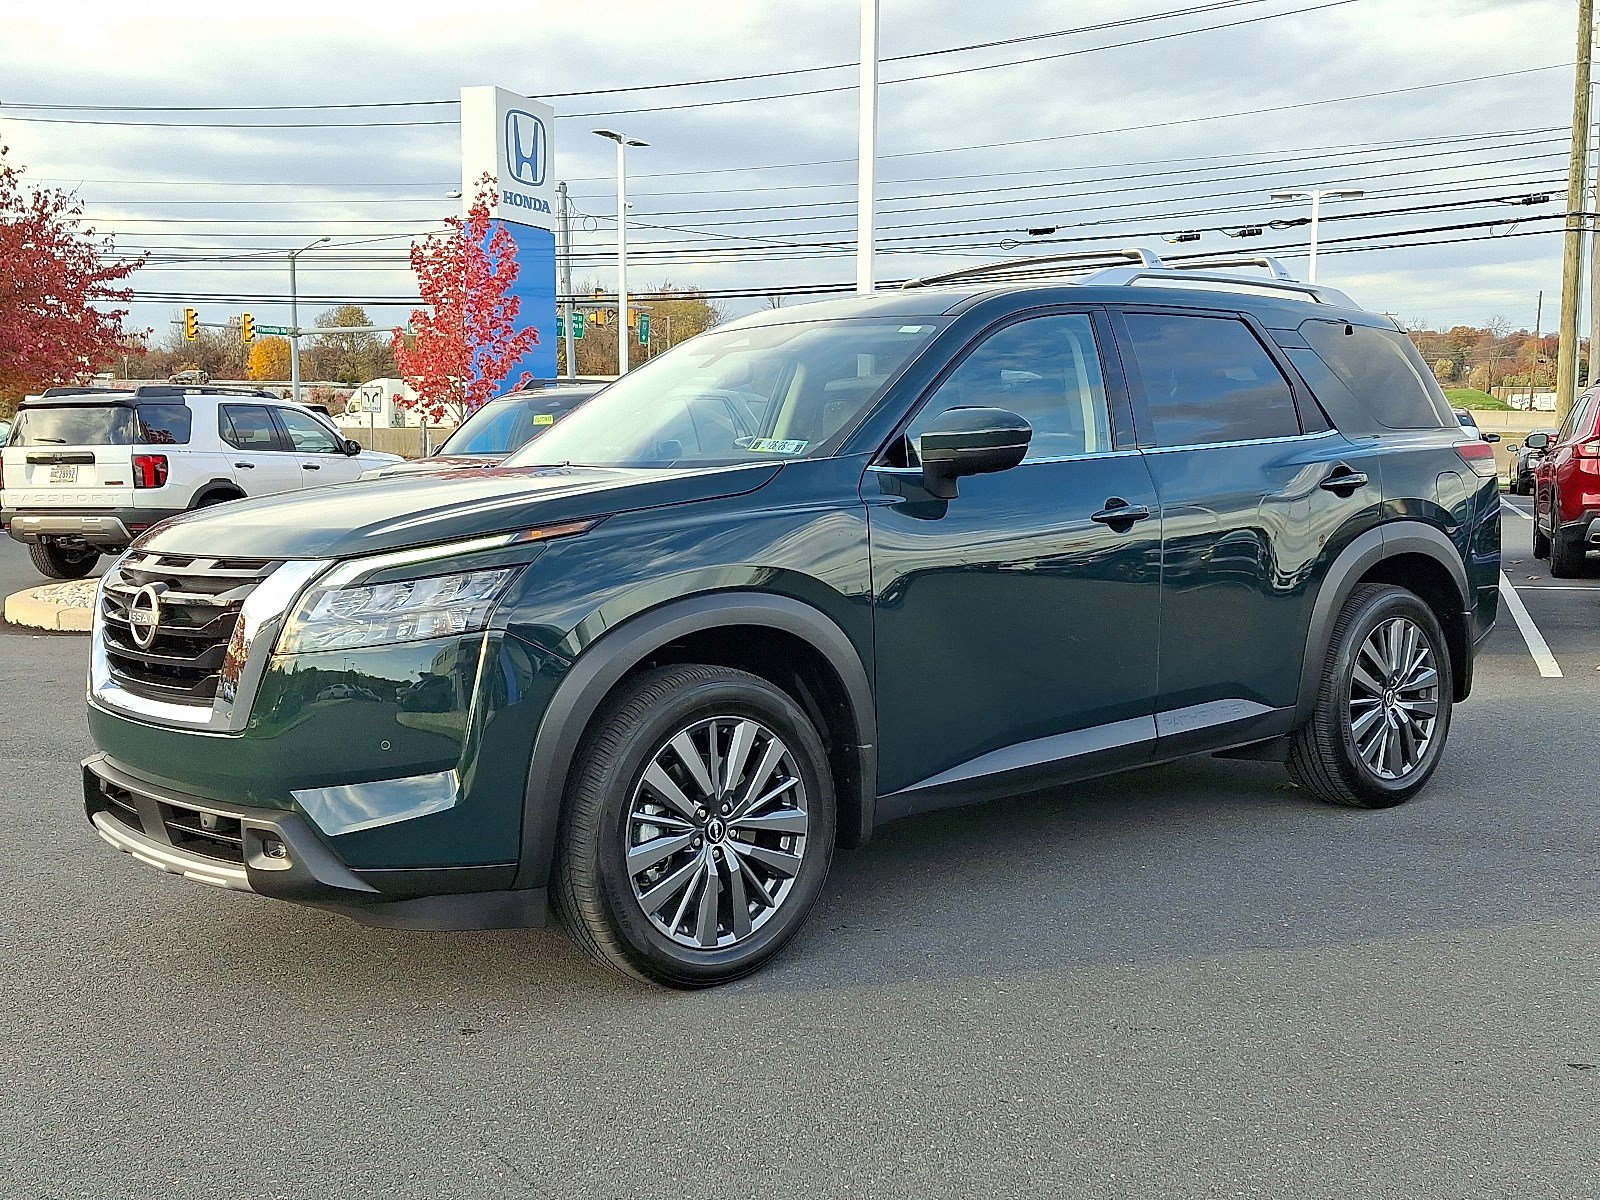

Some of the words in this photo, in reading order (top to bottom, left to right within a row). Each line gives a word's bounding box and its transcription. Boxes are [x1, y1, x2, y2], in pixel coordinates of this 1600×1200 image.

[502, 189, 552, 214] HONDA
[256, 325, 280, 335] Friendship
[10, 494, 120, 504] PASSPORT
